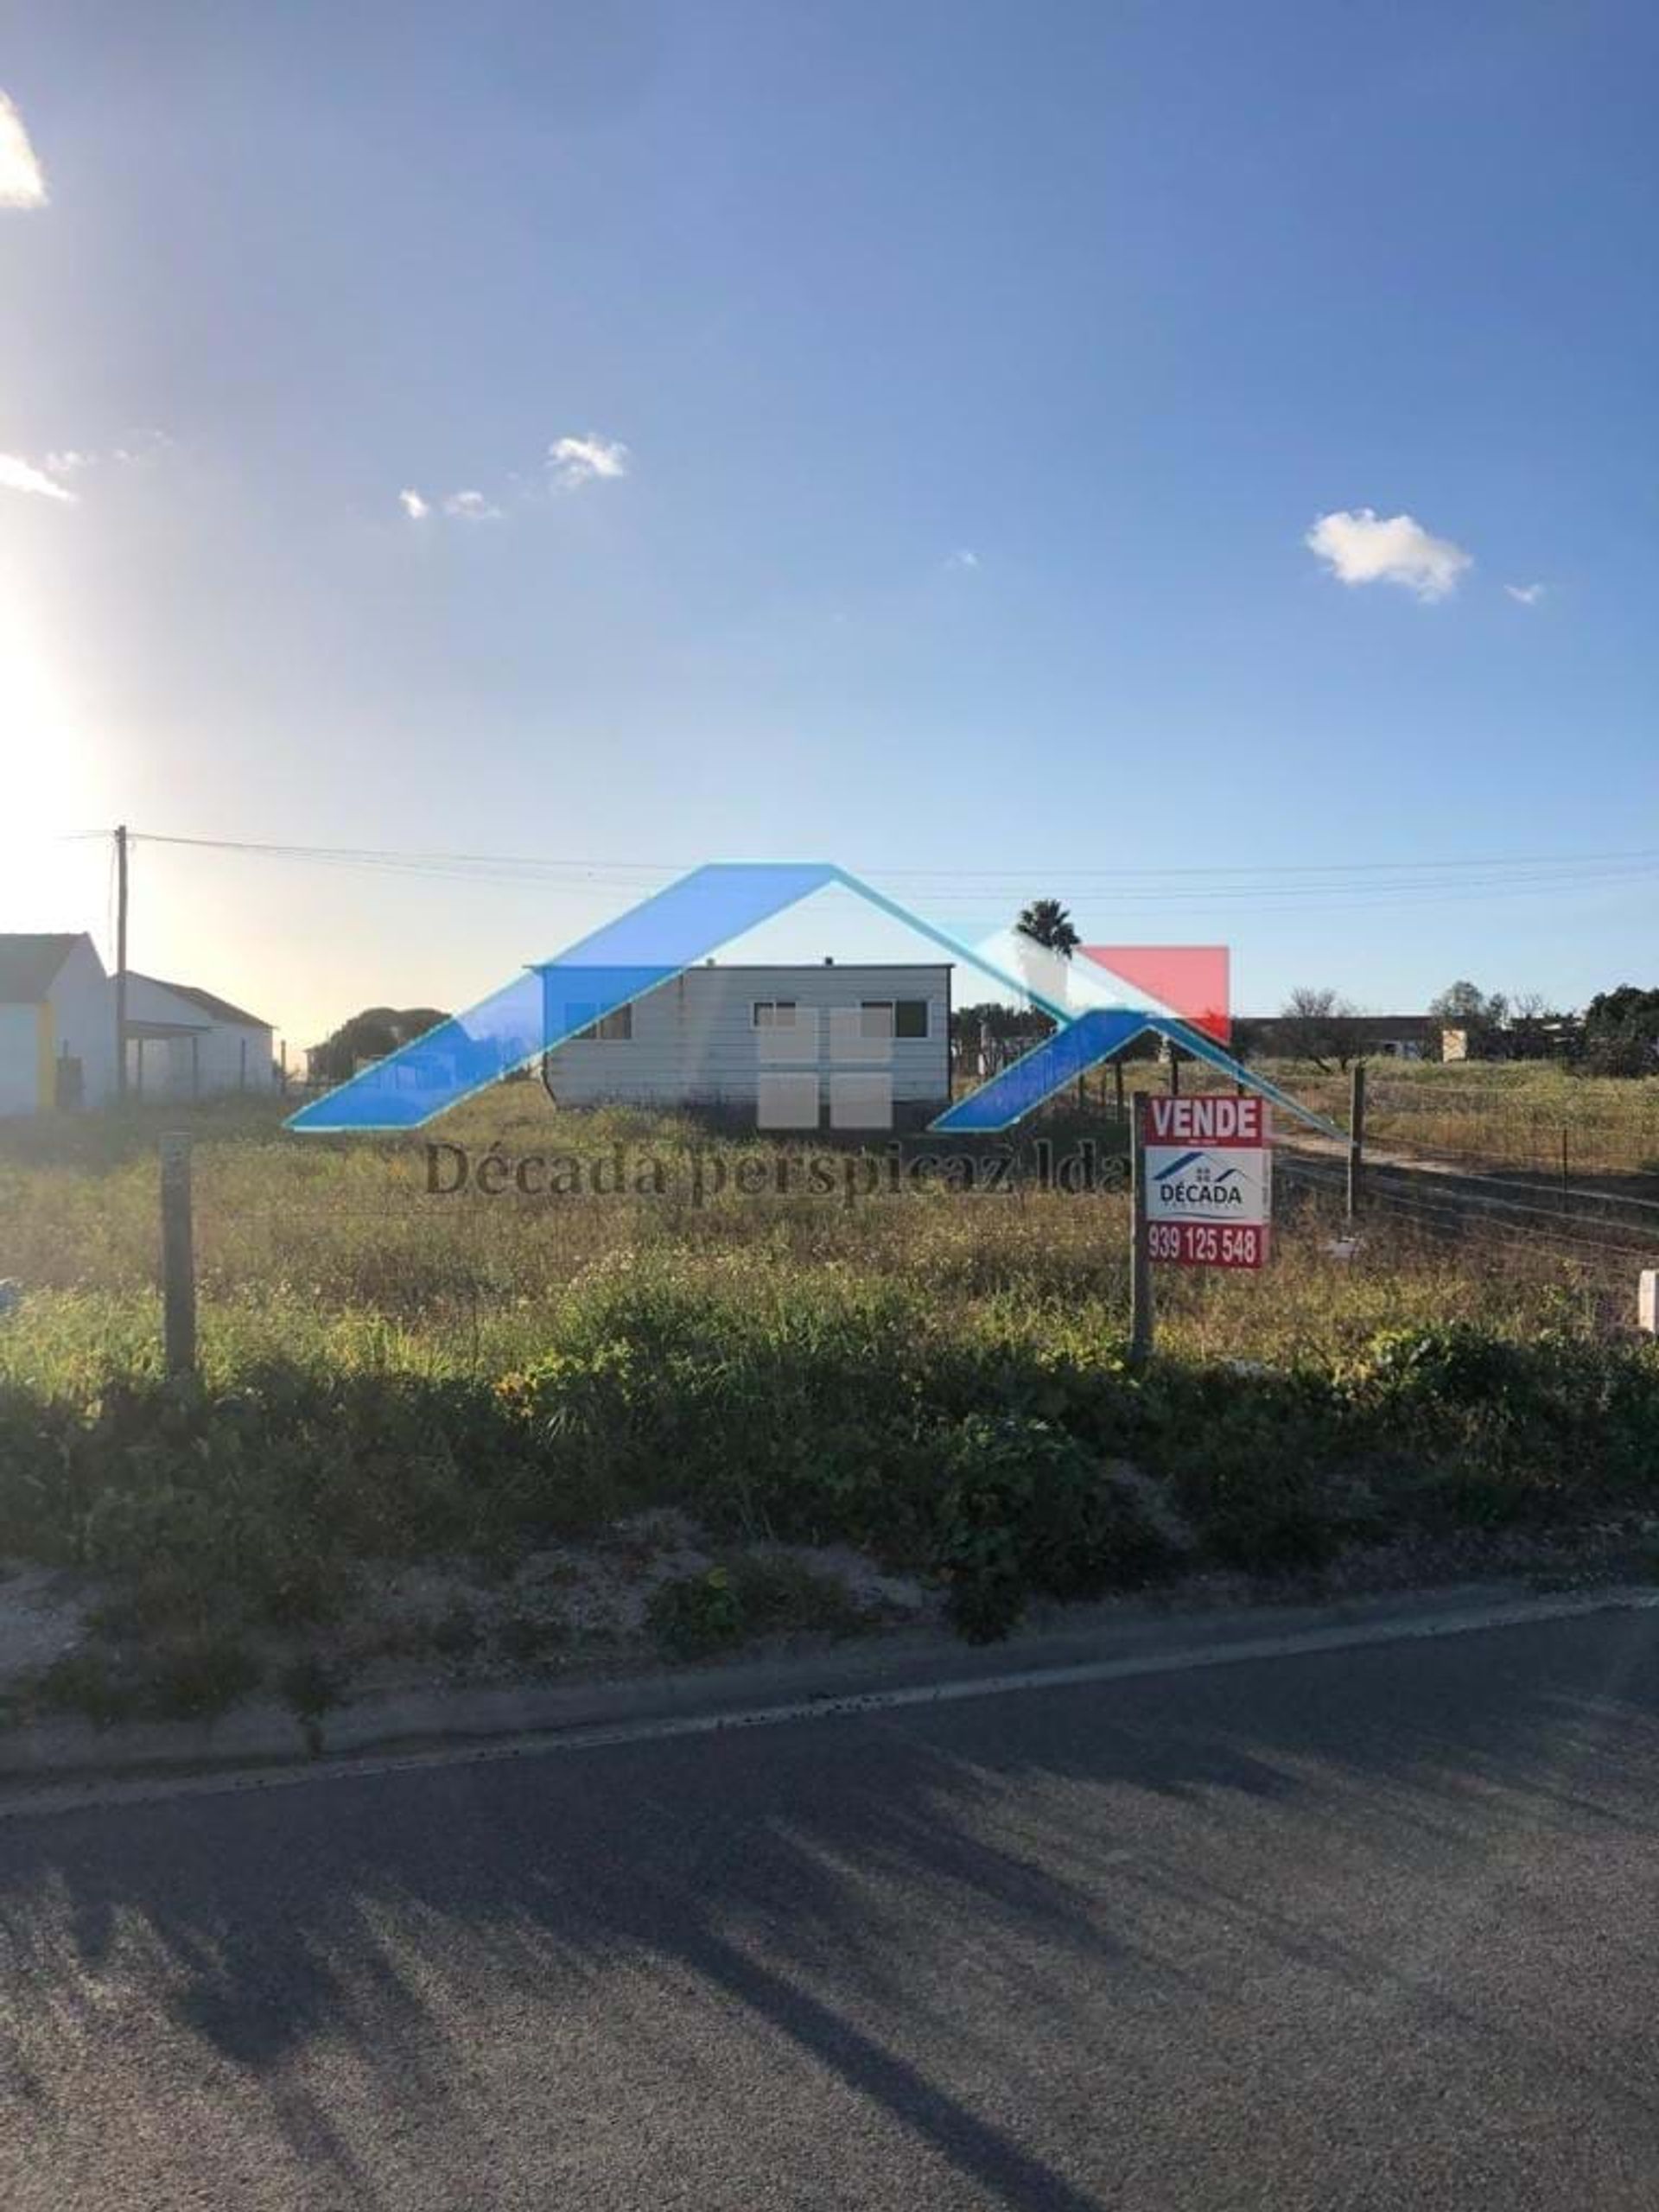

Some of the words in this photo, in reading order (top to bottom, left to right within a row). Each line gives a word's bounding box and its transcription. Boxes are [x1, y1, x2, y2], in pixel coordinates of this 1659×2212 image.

[1152, 1099, 1257, 1137] VENDE
[1160, 1181, 1242, 1204] DÉCADA
[1148, 1224, 1180, 1257] 939
[1186, 1227, 1217, 1261] 125
[1222, 1229, 1255, 1263] 548
